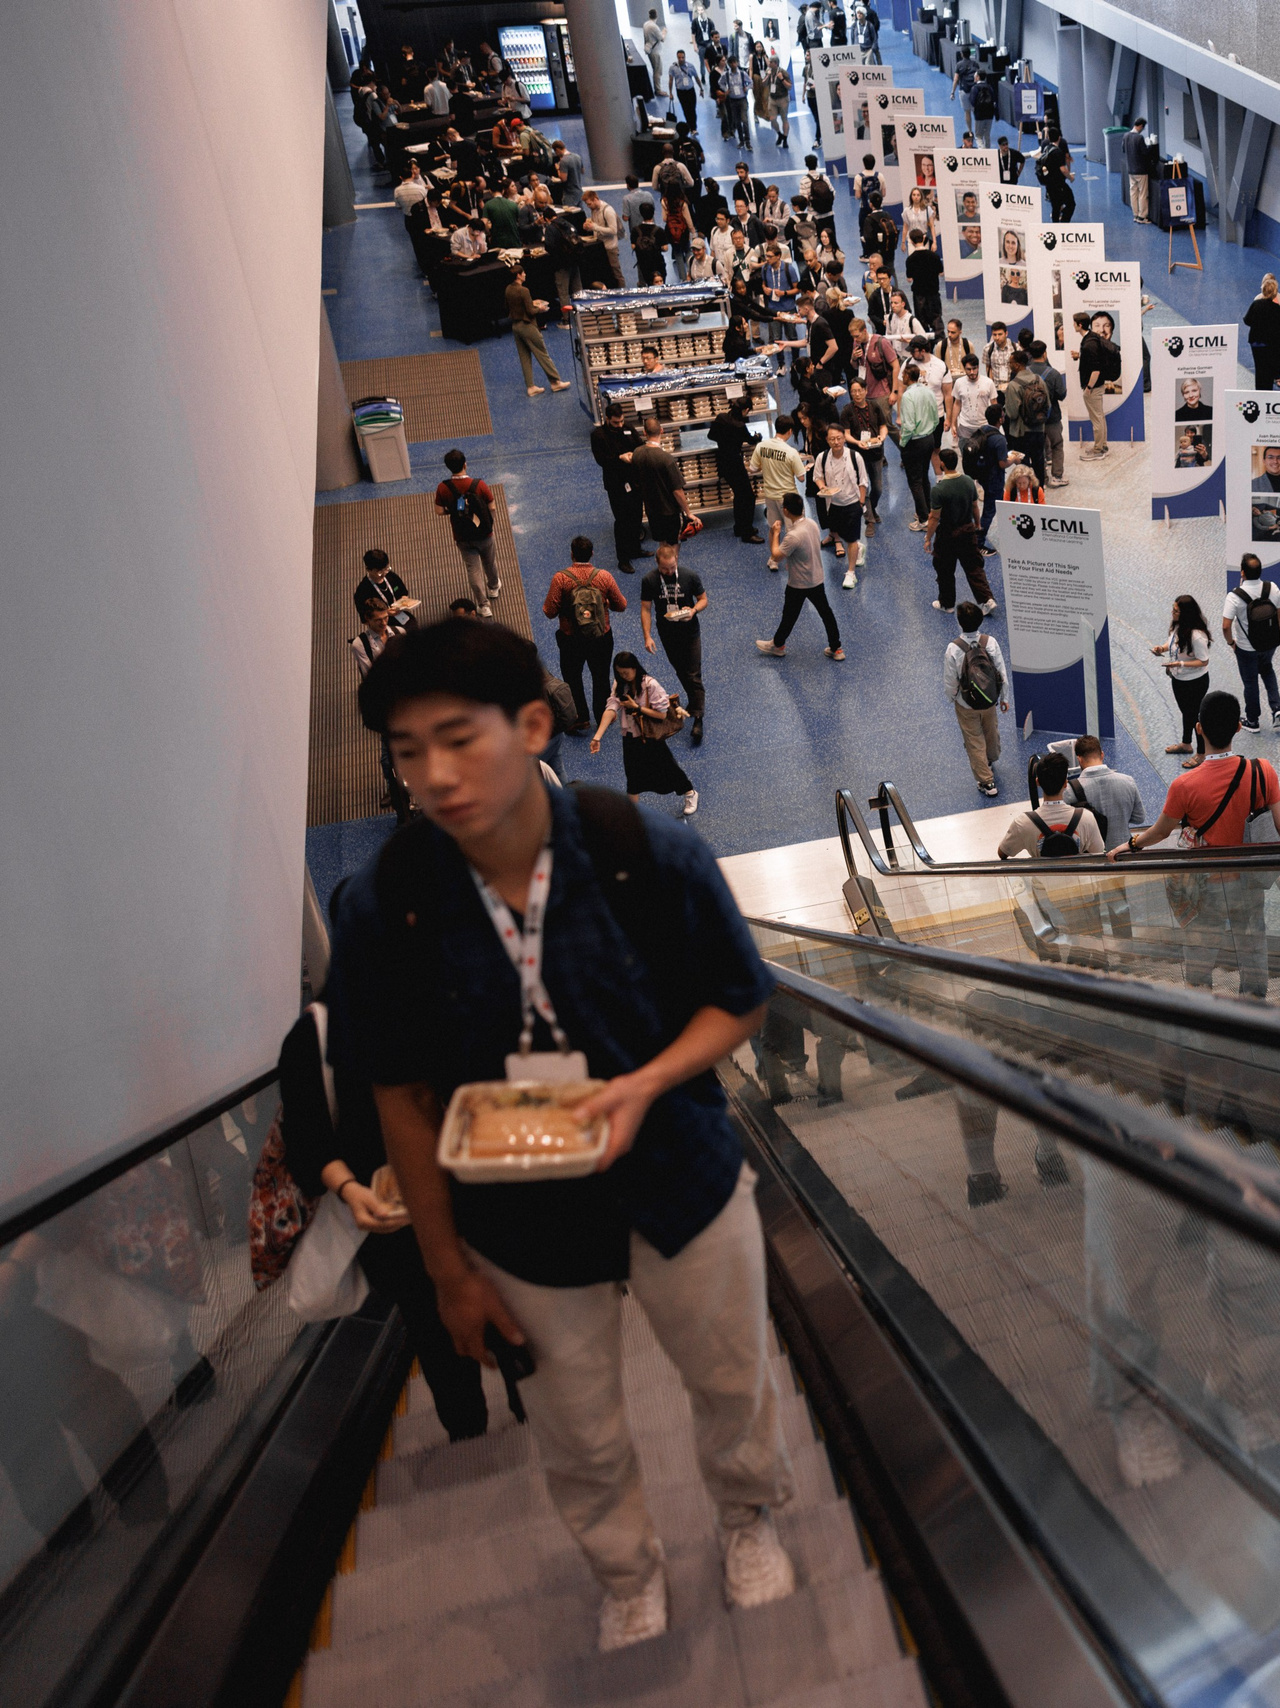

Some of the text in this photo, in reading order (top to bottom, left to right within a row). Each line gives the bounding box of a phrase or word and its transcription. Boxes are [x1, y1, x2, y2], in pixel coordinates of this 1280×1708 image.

[832, 52, 856, 61] ICML
[862, 72, 886, 80] ICML
[892, 96, 917, 104] ICML
[920, 124, 947, 132] ICML
[962, 157, 991, 166] ICML
[1006, 194, 1034, 205] ICML
[1061, 233, 1095, 242] ICML
[1095, 272, 1130, 282] ICML
[1189, 336, 1227, 348] ICML
[761, 447, 786, 462] VOLUNTEER
[1040, 518, 1089, 534] ICML
